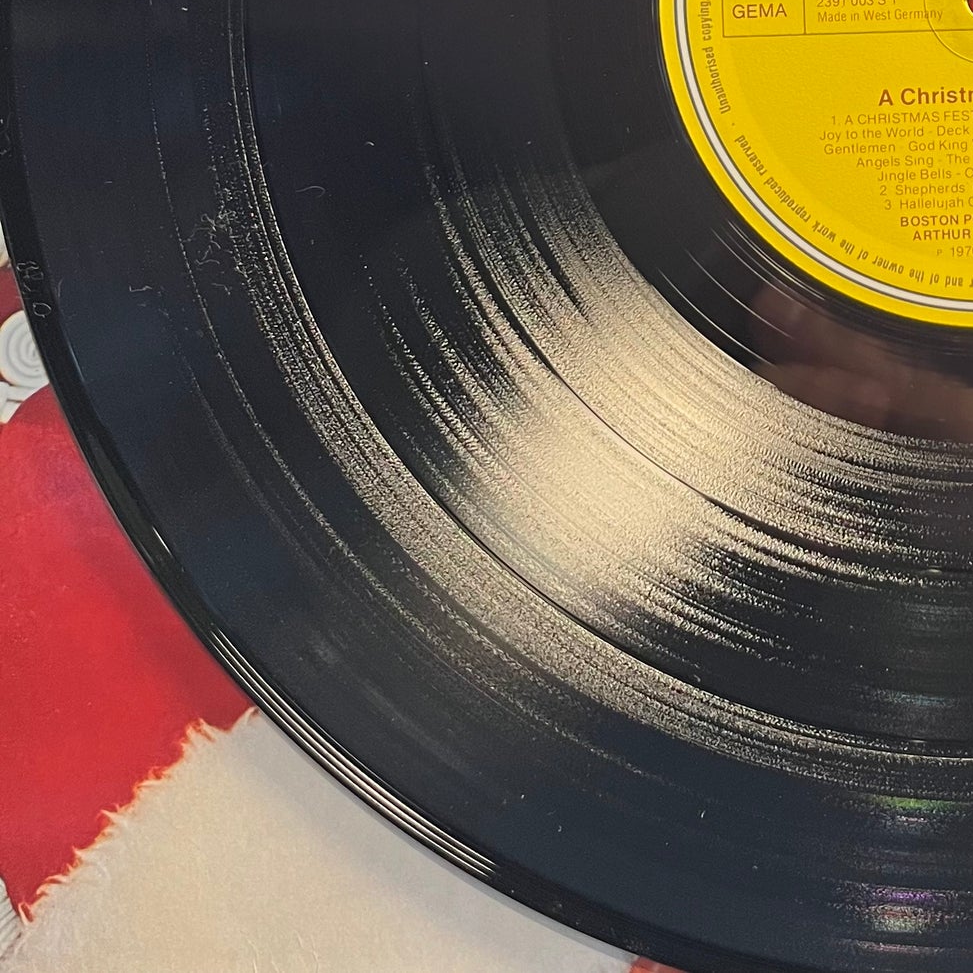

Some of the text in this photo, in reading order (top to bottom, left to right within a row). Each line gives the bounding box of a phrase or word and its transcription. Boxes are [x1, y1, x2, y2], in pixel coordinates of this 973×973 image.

[732, 3, 787, 19] GEMA
[818, 9, 943, 22] Made in West Germany
[702, 47, 731, 114] Unauthorised
[878, 89, 893, 106] A
[845, 115, 853, 125] A
[858, 112, 940, 125] CHRISTMAS
[819, 131, 841, 142] Joy
[846, 130, 858, 139] to
[862, 129, 881, 138] the
[886, 127, 924, 138] World
[937, 125, 969, 136] Deck
[824, 143, 895, 155] Gentlemen
[908, 141, 935, 152] God
[939, 140, 968, 152] King
[734, 135, 767, 176] reserved
[856, 156, 900, 170] Angels
[905, 155, 934, 167] Sing
[948, 154, 969, 164] The
[878, 170, 916, 183] Jingle
[920, 169, 952, 180] Bells
[764, 177, 811, 222] reproduced
[900, 197, 964, 210] Hallelujah
[900, 215, 959, 227] BOSTON
[812, 221, 836, 242] work
[913, 229, 970, 241] ARTHUR
[840, 239, 855, 255] the
[857, 249, 868, 260] of
[872, 256, 904, 274] owner
[909, 269, 924, 282] the
[929, 274, 939, 285] of
[945, 276, 963, 287] and
